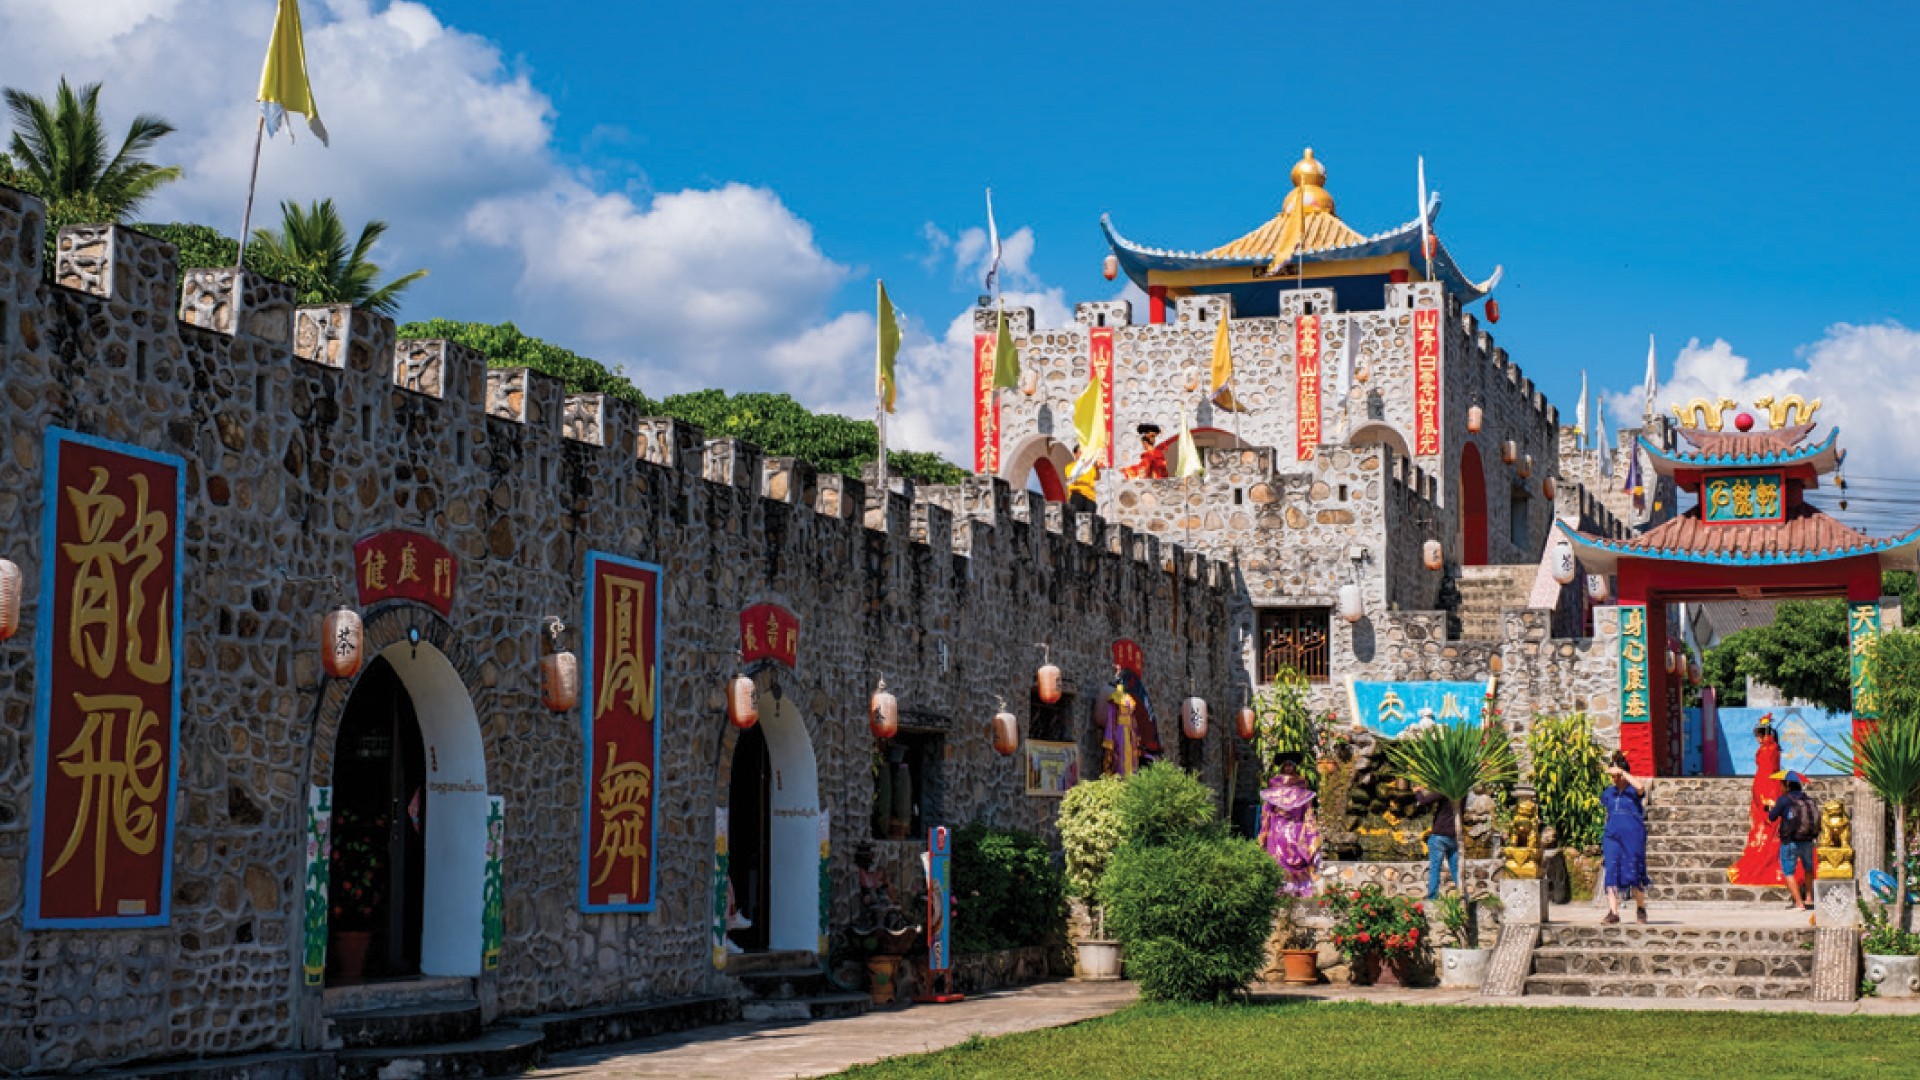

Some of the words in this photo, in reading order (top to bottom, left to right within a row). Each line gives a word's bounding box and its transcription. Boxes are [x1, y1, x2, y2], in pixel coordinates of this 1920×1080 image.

[334, 626, 355, 657] 茶
[361, 541, 452, 600] 健康門
[45, 465, 172, 912] 龍飛
[591, 573, 655, 898] 鳳舞
